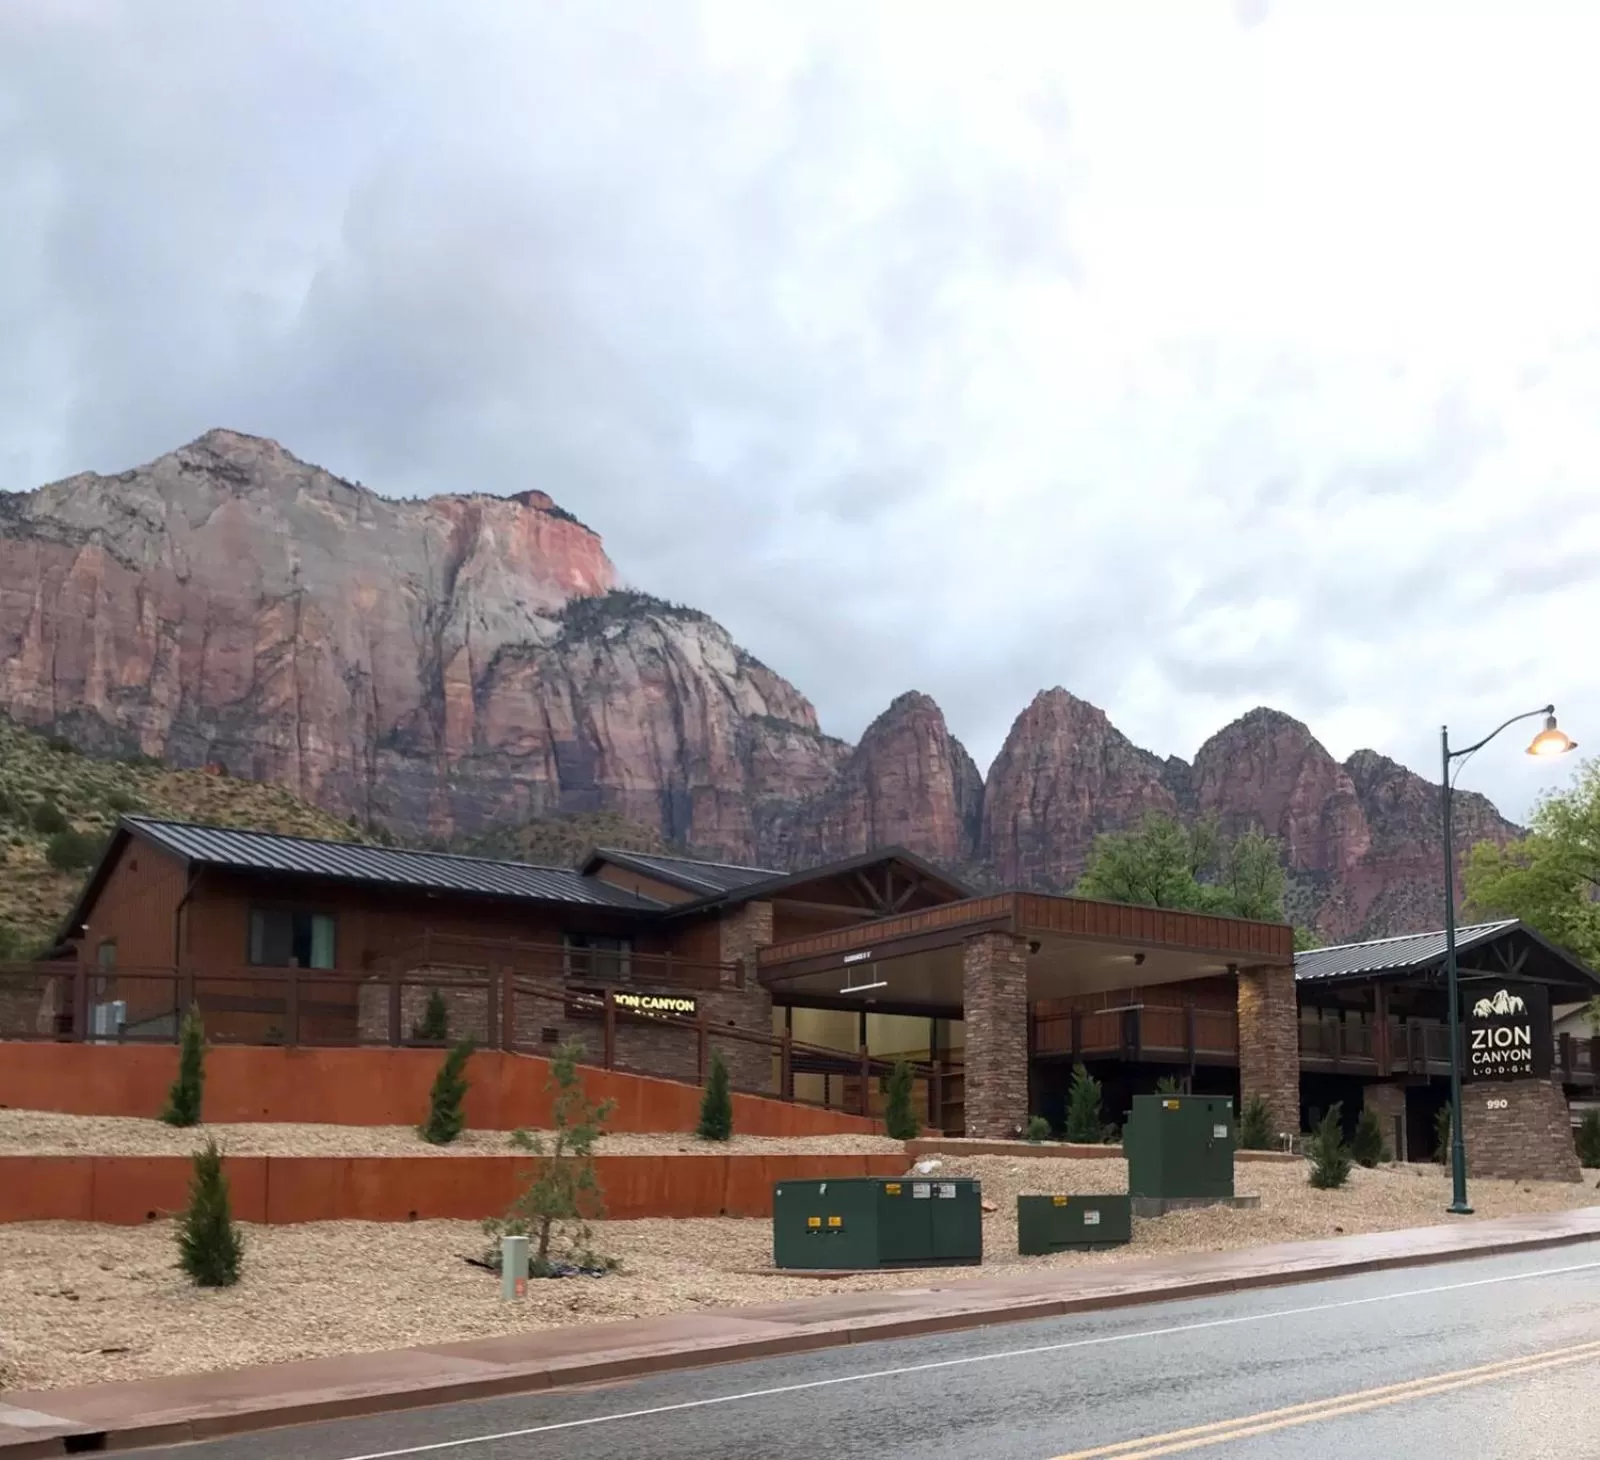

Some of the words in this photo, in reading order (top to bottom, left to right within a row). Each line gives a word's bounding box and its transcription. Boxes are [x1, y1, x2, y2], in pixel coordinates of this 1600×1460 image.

[613, 994, 639, 1008] ION
[641, 996, 695, 1011] CANYON
[1471, 1025, 1531, 1049] ZION
[1472, 1048, 1532, 1064] CANYON
[1487, 1099, 1508, 1109] 990
